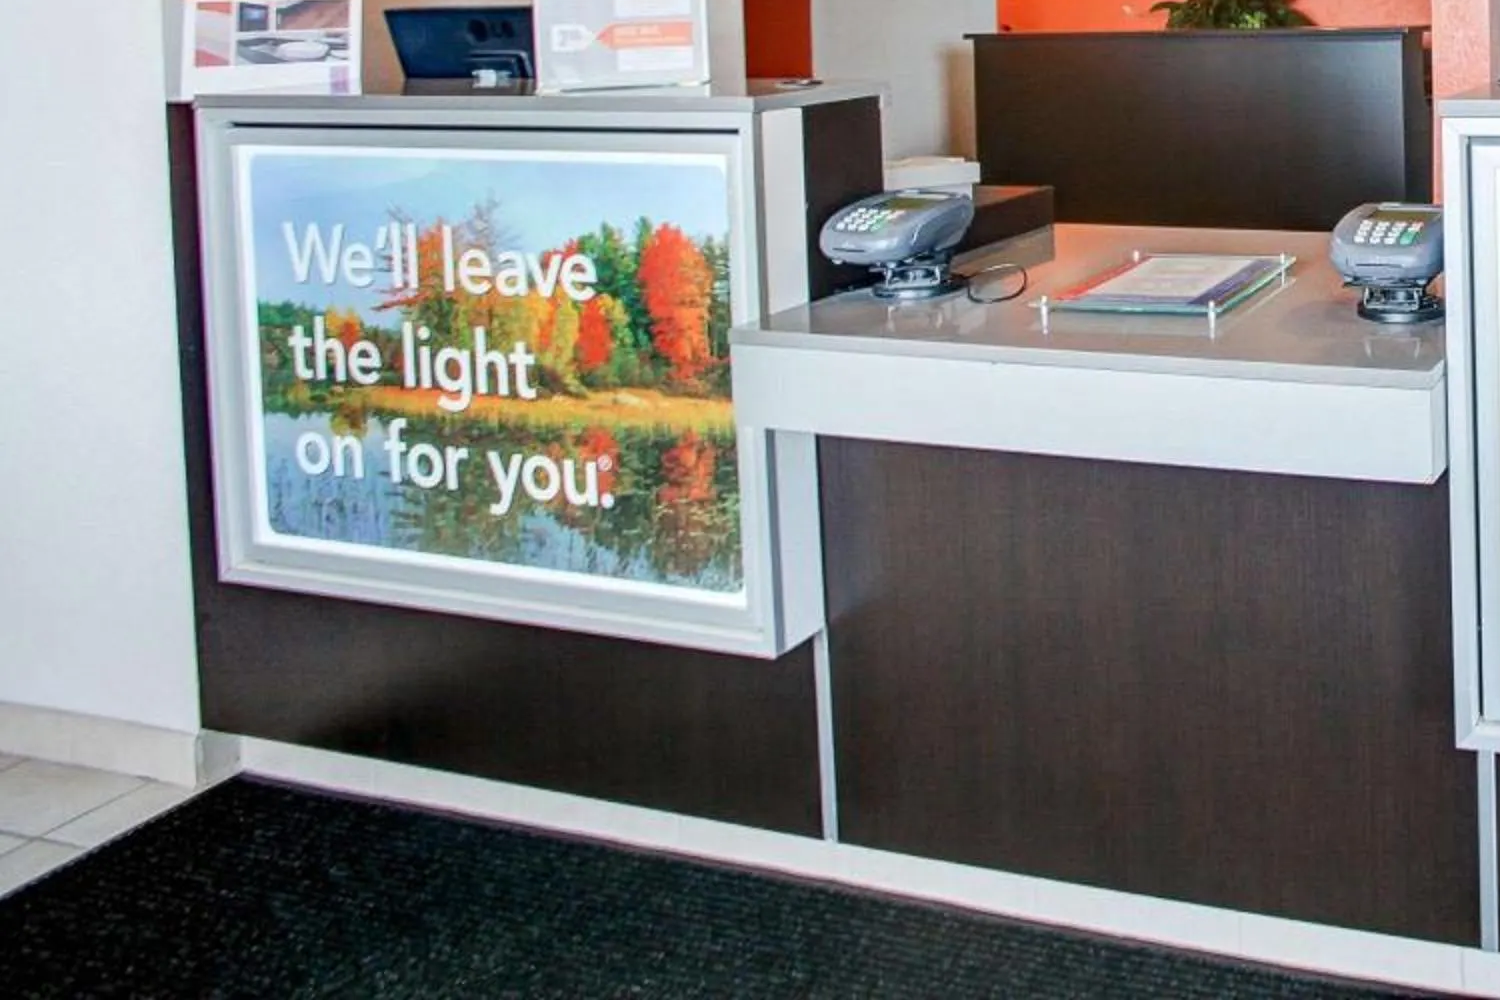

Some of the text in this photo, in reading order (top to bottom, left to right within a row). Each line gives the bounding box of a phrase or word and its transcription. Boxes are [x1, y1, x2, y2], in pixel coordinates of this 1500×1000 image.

[282, 221, 599, 301] We'll leave
[288, 315, 538, 413] the light
[296, 431, 365, 480] on
[384, 418, 468, 492] for
